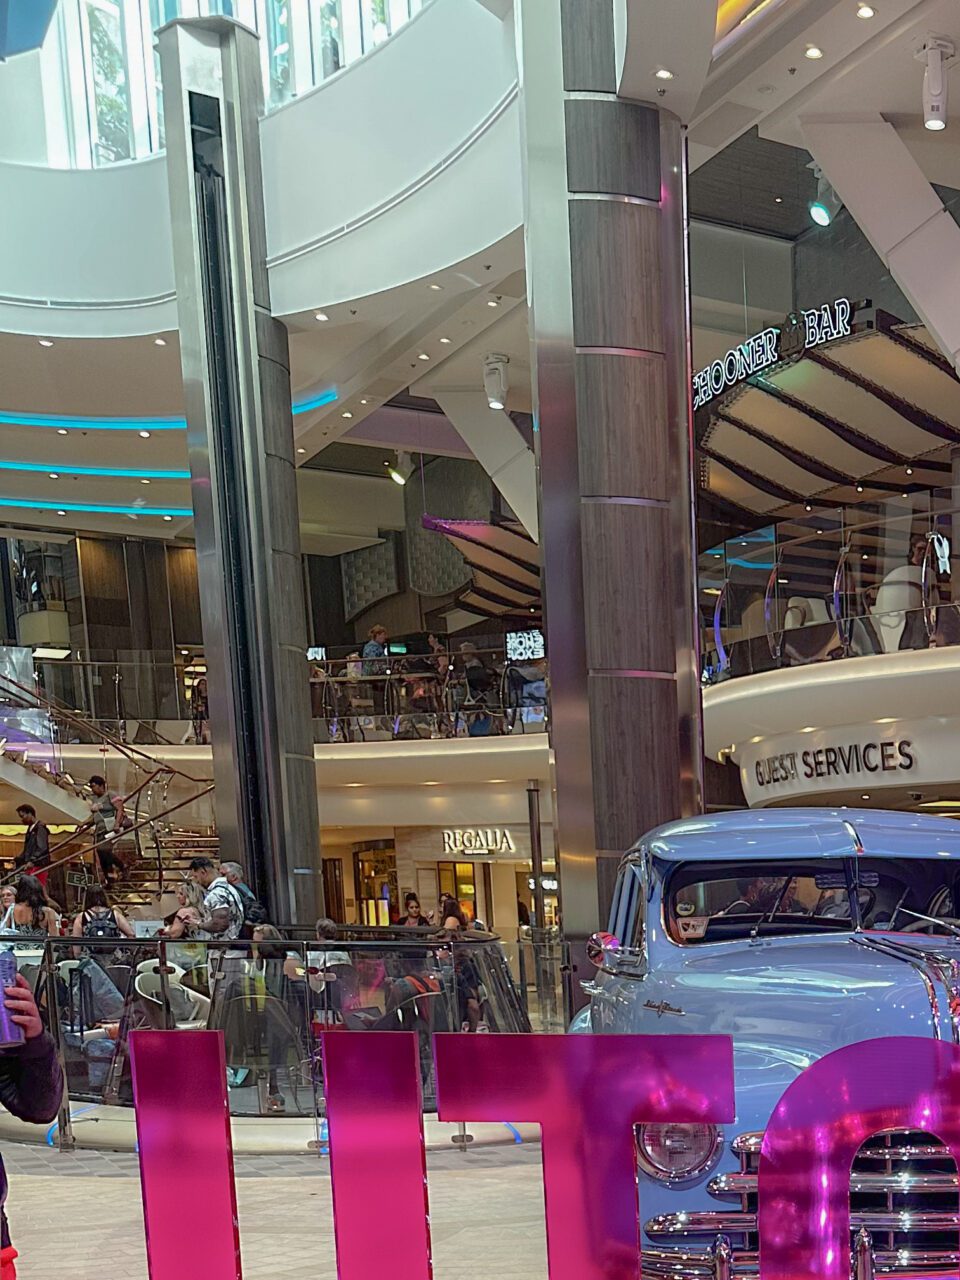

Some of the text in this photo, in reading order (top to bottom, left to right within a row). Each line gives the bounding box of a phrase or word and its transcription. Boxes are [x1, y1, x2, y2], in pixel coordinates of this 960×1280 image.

[805, 298, 850, 349] BAR
[755, 740, 914, 787] GUEST SERVICES
[442, 829, 516, 853] REGALIA
